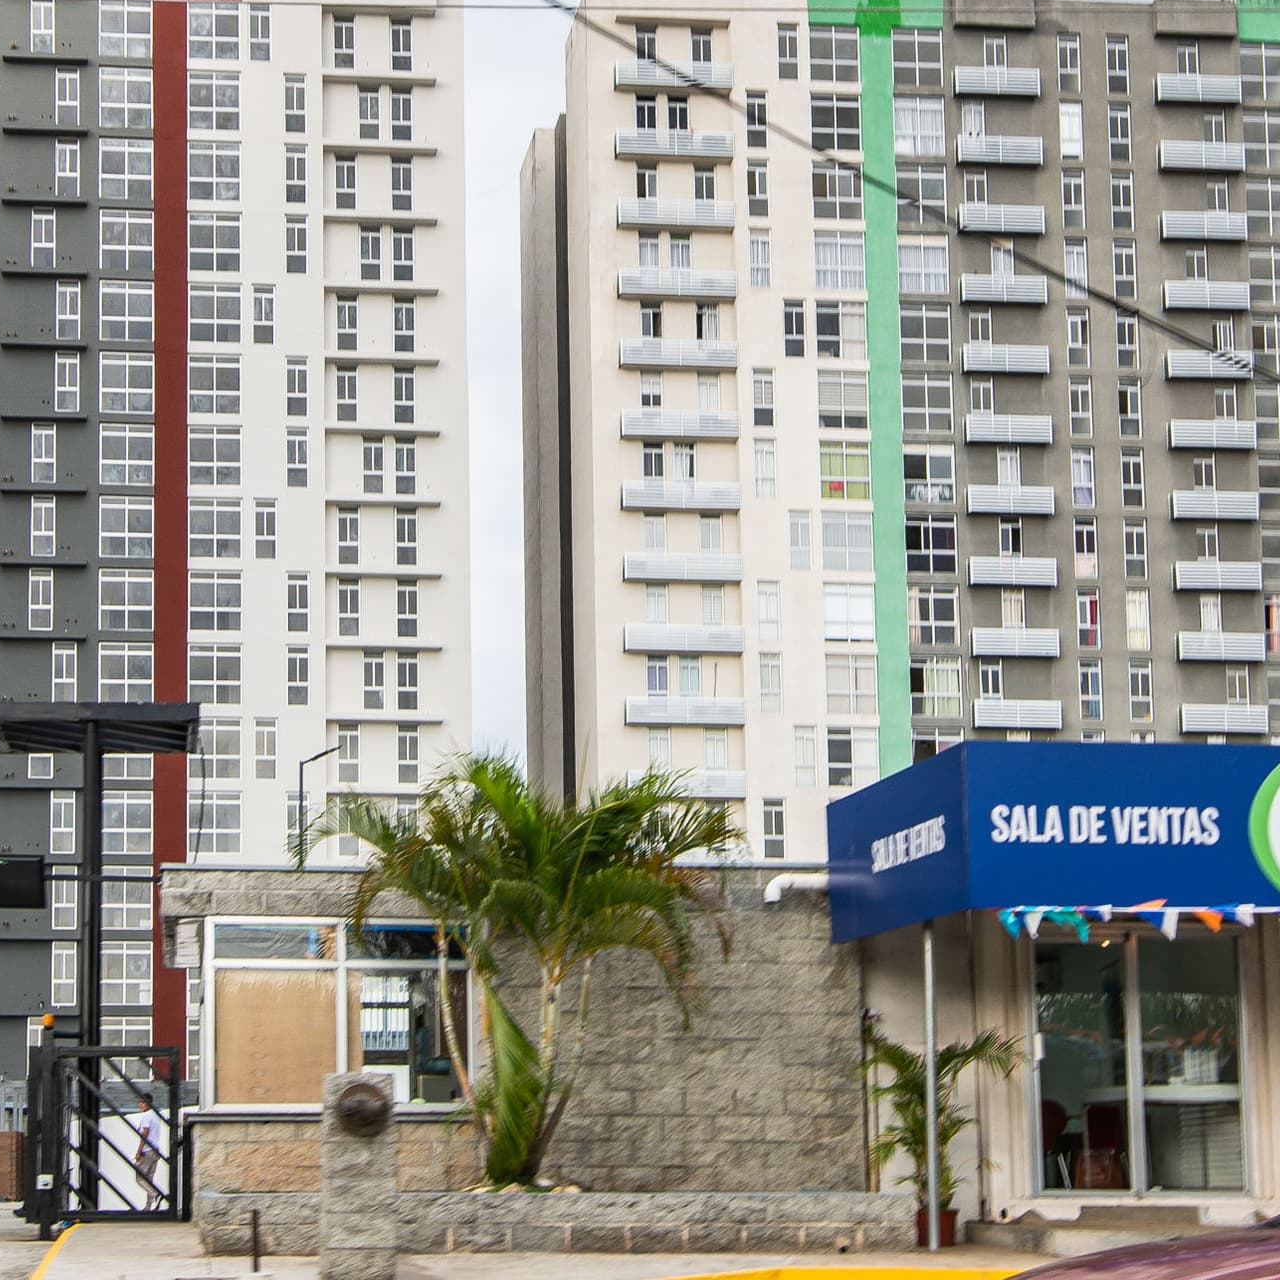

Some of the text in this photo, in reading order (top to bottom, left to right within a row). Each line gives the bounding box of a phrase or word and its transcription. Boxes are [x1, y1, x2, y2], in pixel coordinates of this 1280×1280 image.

[871, 814, 946, 874] SALA DE VENTAS
[991, 804, 1220, 846] SALA DE VENTAS
